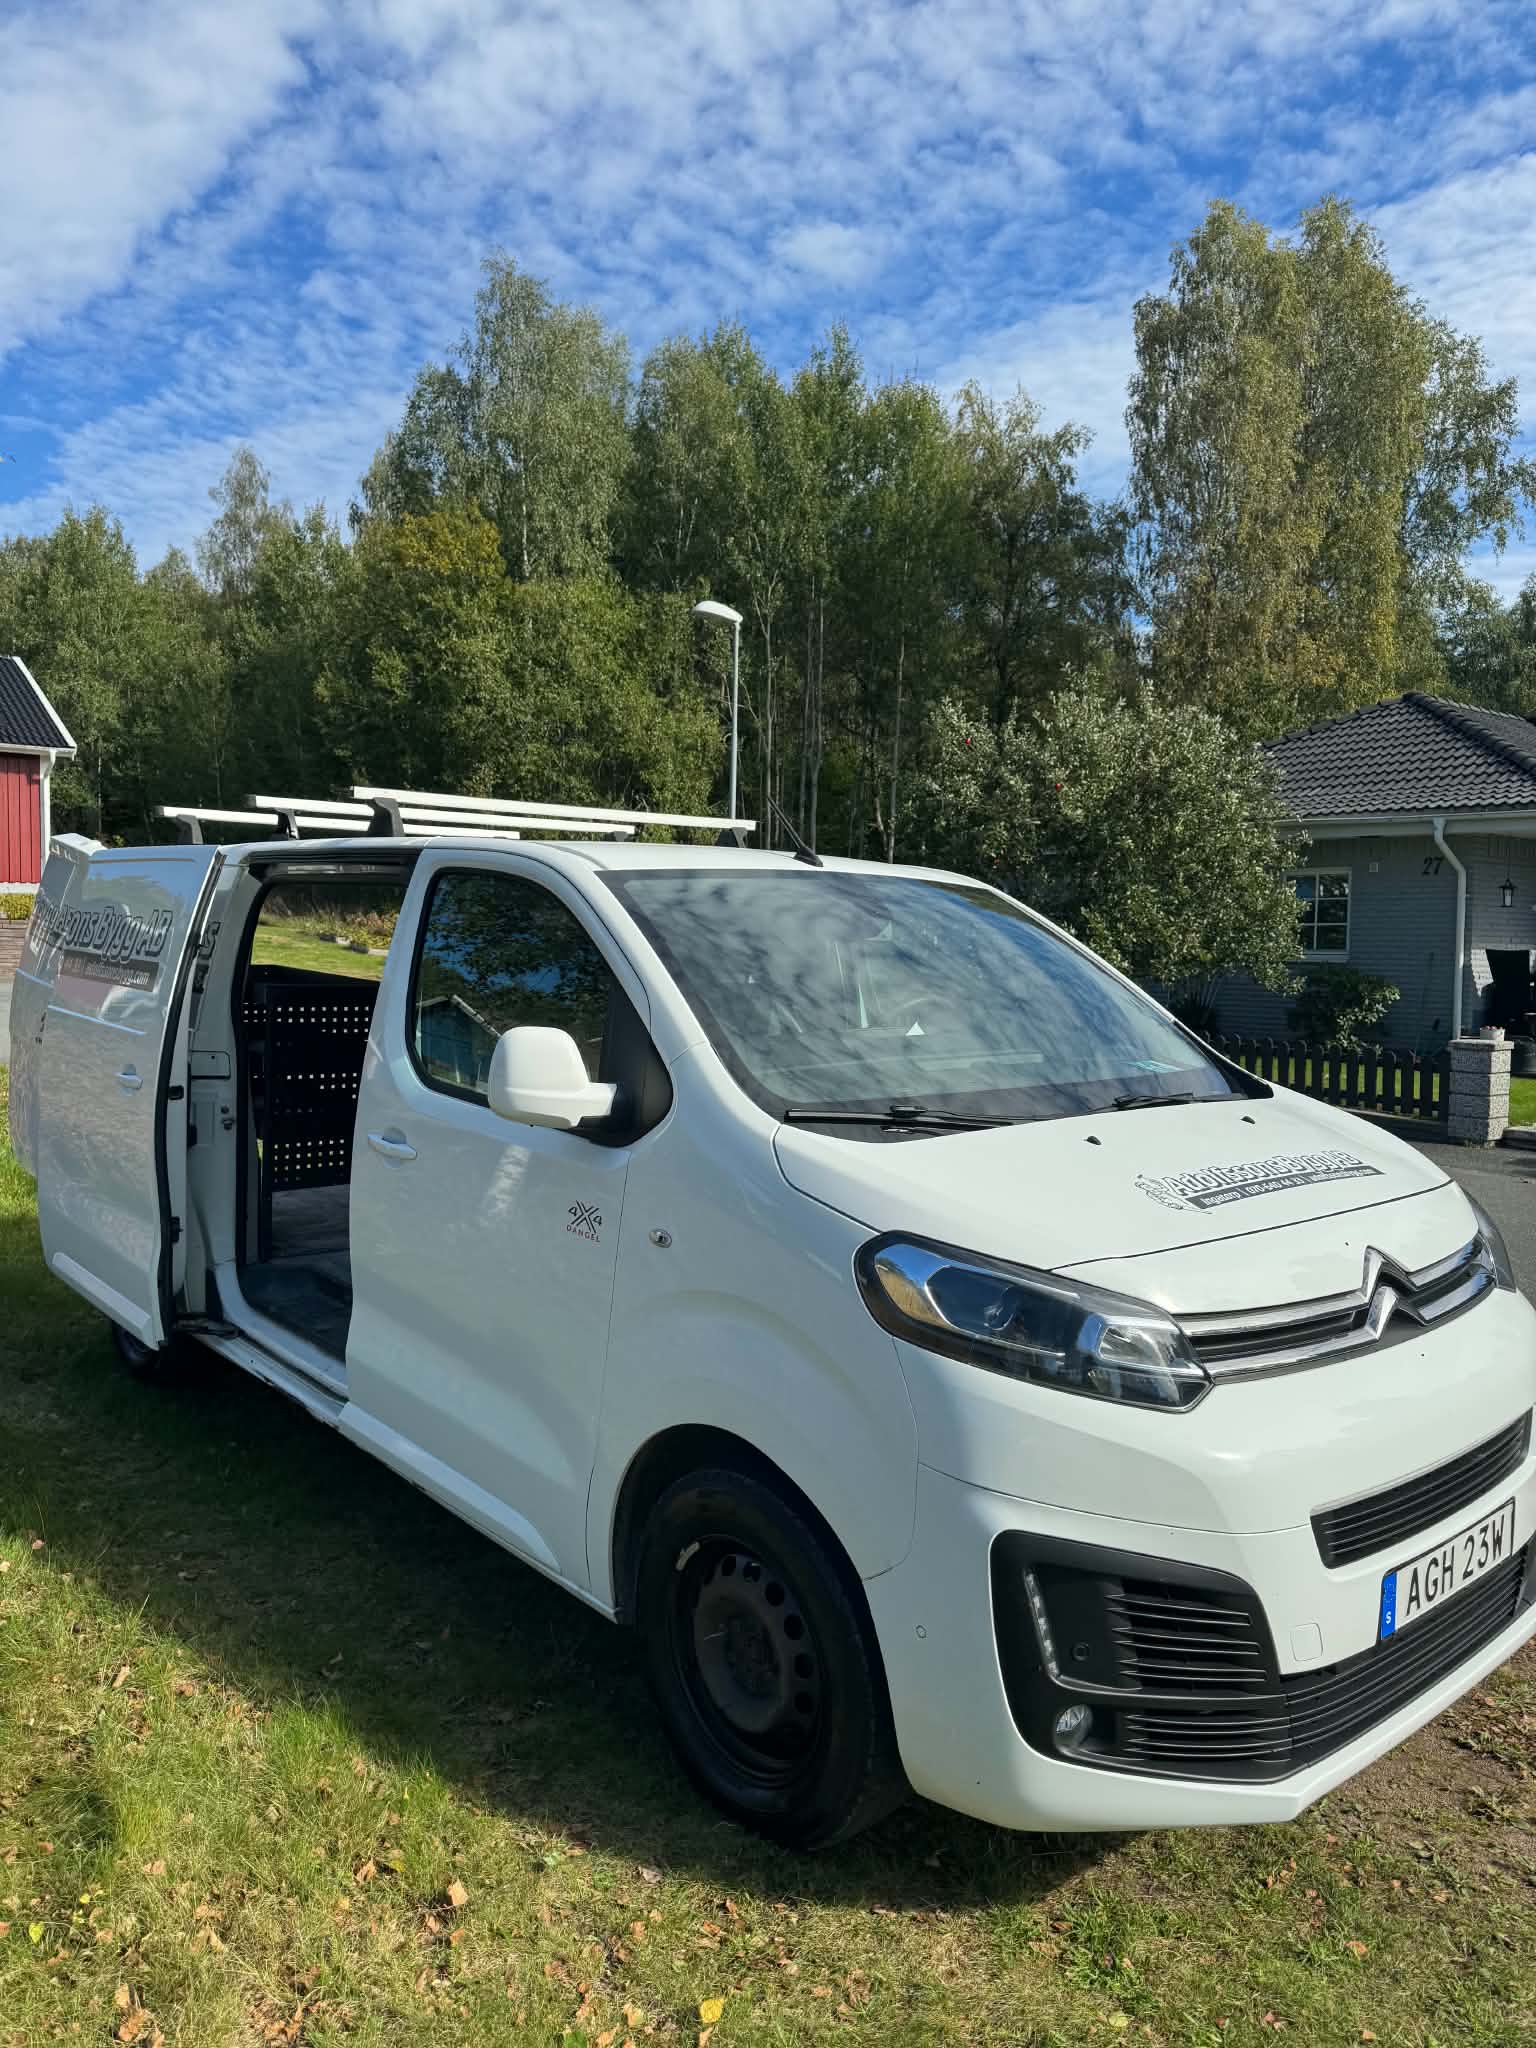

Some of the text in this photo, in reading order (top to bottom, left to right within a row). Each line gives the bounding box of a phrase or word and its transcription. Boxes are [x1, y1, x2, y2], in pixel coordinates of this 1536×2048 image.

[1421, 856, 1445, 875] 27
[97, 905, 143, 963] Bygg
[135, 909, 173, 957] AB
[1161, 1158, 1292, 1196] Adolfssons
[1272, 1155, 1343, 1175] Bygg
[1321, 1151, 1362, 1167] AB
[1201, 1190, 1241, 1206] Ingatorp
[566, 1224, 601, 1243] DANGEL
[1406, 1514, 1505, 1616] AGH 23W
[1385, 1611, 1392, 1624] S
